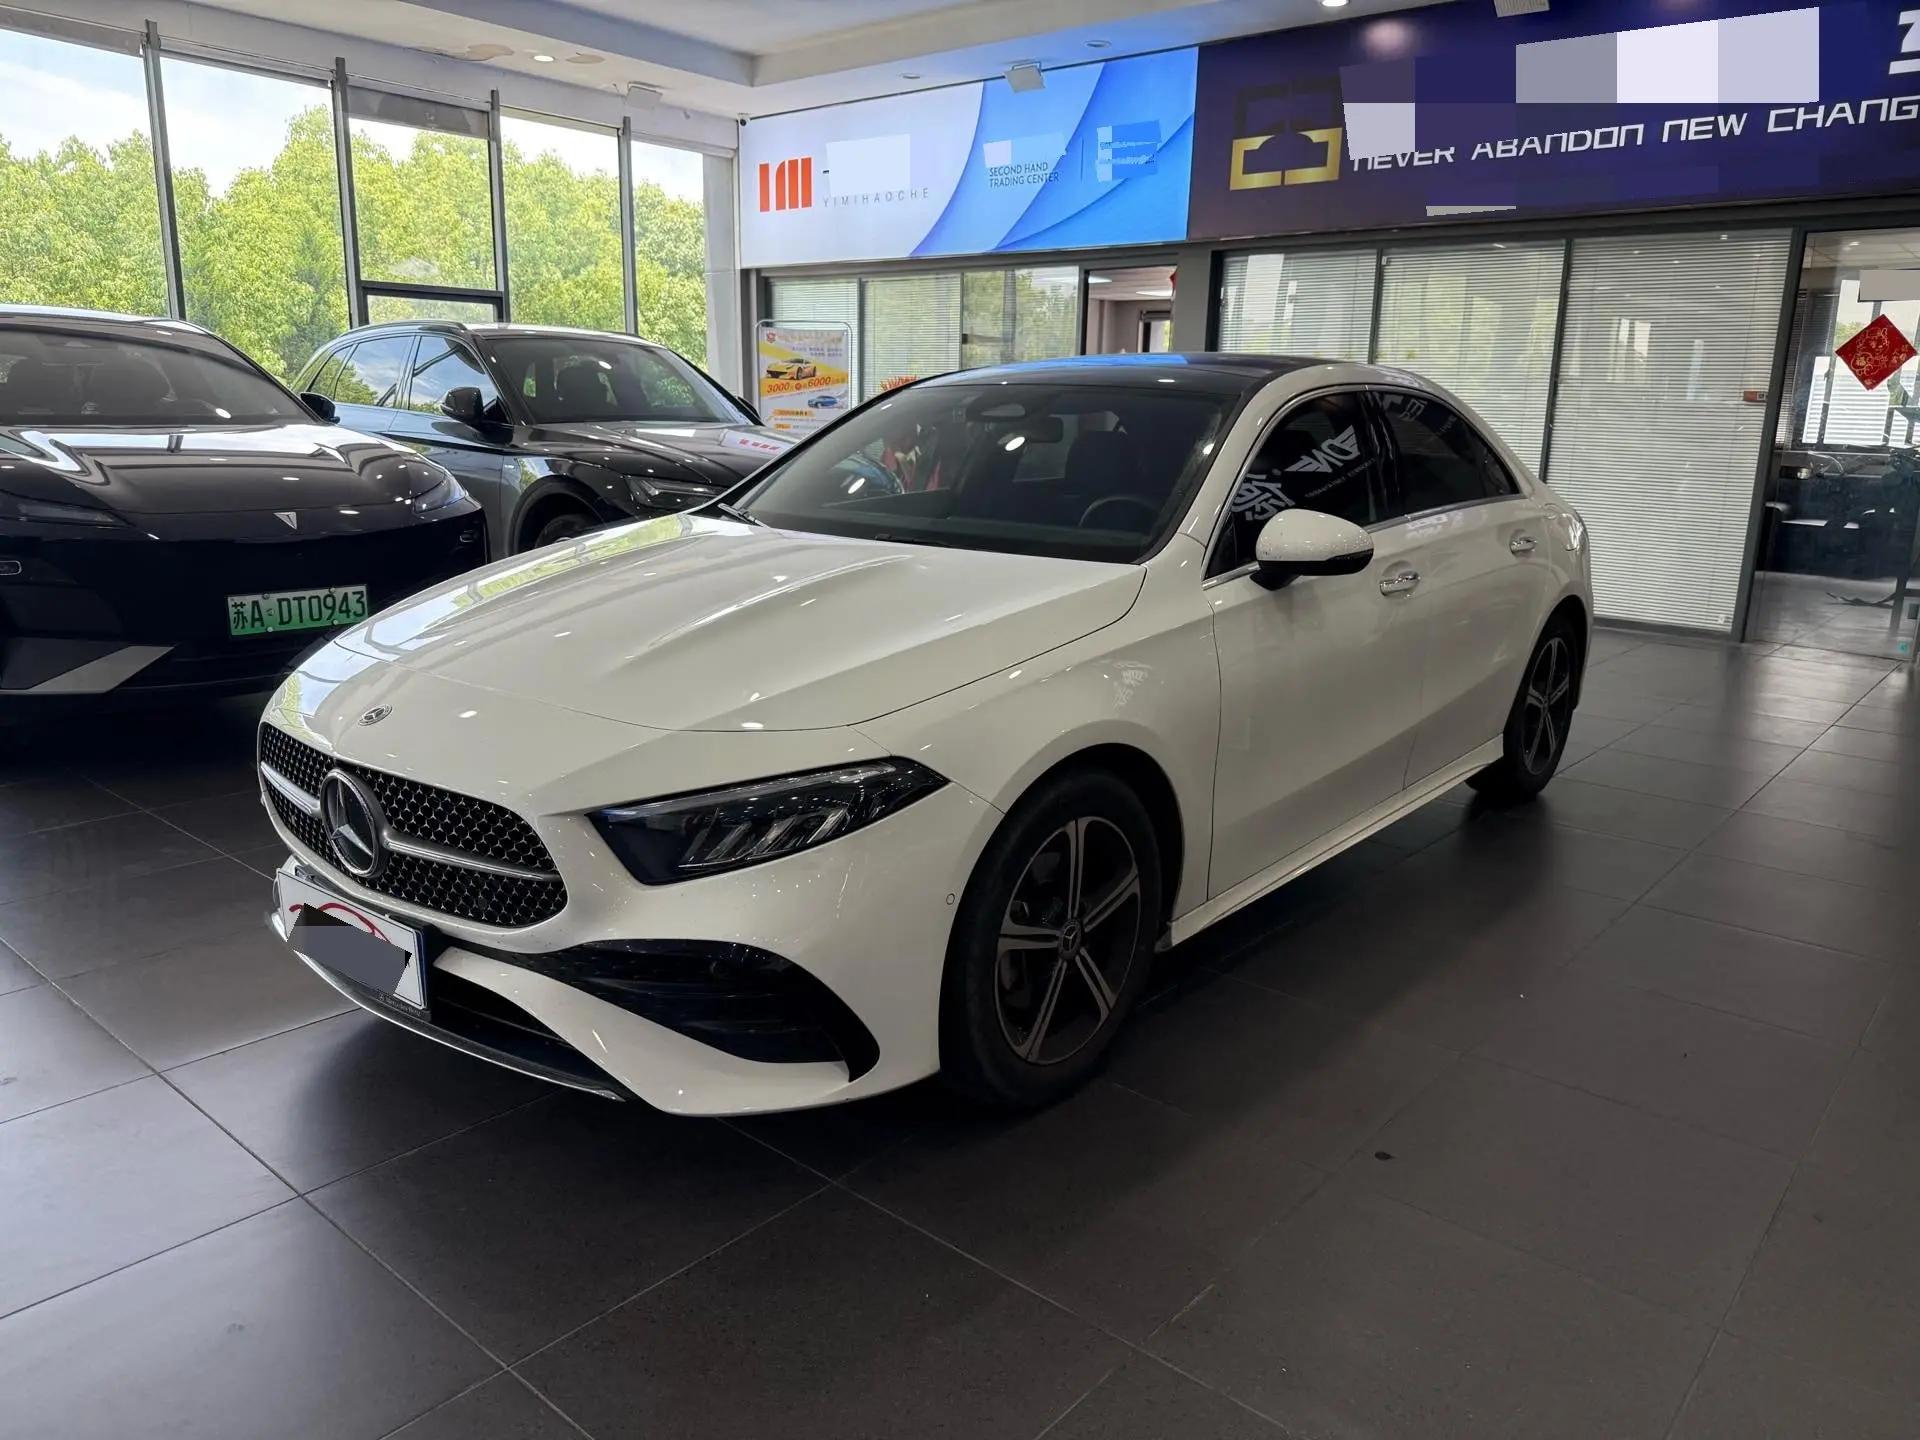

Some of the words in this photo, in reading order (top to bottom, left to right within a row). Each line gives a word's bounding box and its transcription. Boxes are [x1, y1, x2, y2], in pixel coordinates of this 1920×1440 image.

[1471, 123, 1645, 161] ABANDON
[1661, 113, 1748, 142] NEW
[989, 164, 1022, 177] SECOND
[1024, 161, 1049, 174] HAND
[989, 175, 1025, 188] TRADING
[1026, 171, 1060, 184] CENTER
[823, 187, 929, 208] YIMIHAOCHE
